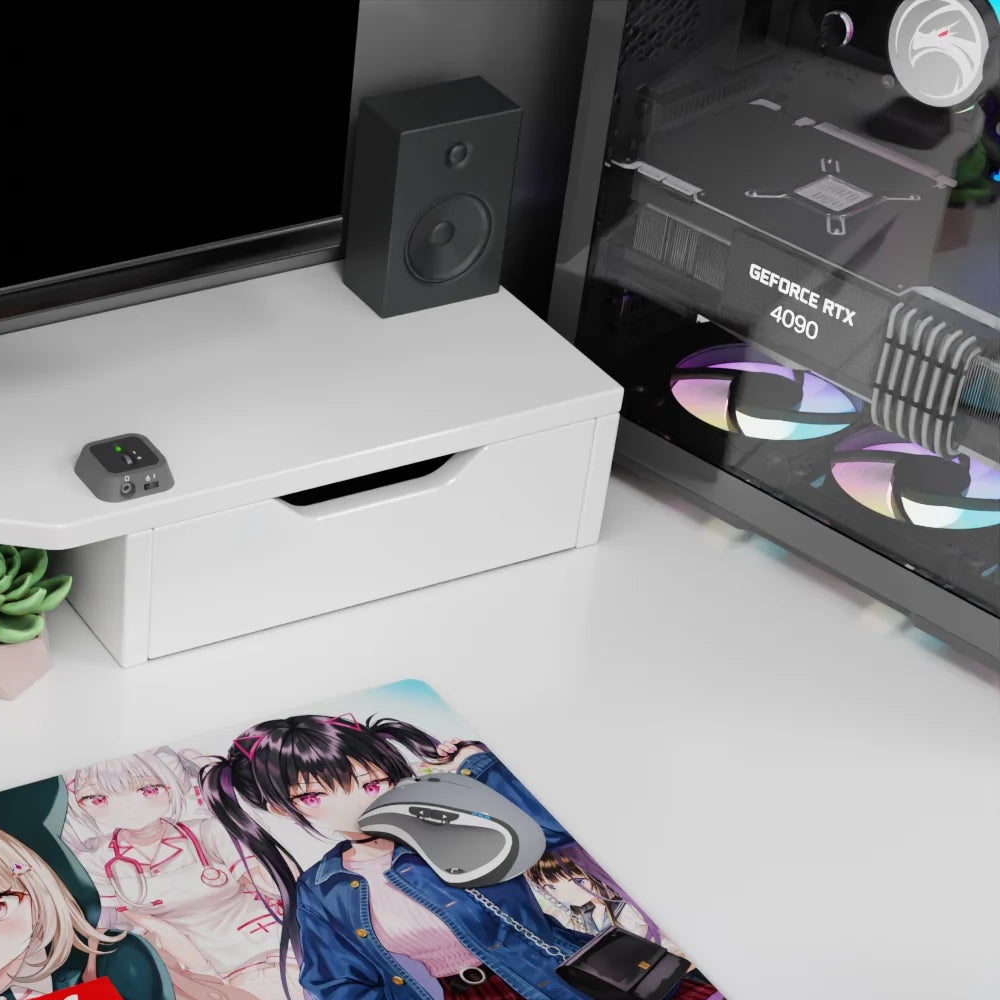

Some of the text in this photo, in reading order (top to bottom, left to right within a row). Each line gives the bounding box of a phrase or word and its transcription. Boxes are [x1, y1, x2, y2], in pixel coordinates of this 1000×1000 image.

[749, 263, 856, 327] GEFORCE RTX
[770, 305, 819, 340] 4090
